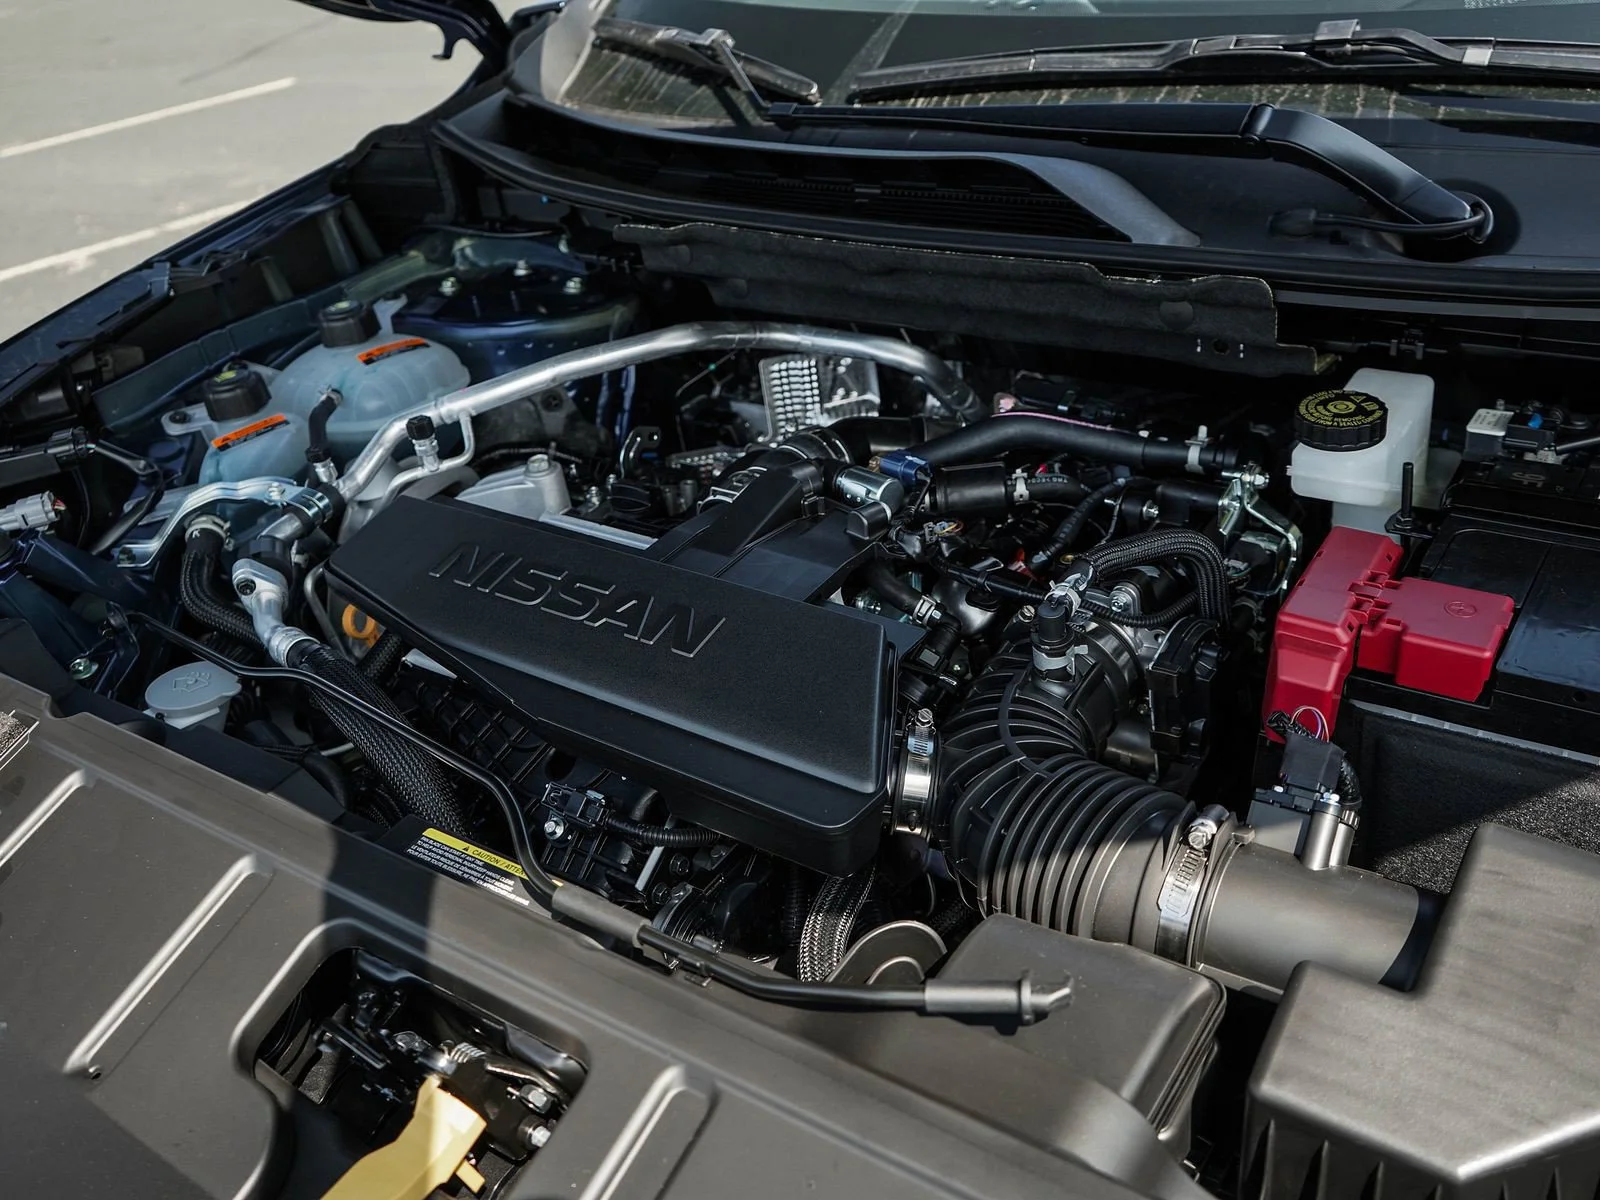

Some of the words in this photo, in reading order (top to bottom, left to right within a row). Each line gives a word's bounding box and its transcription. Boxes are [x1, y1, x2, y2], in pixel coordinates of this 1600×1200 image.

[429, 543, 726, 658] NISSAN
[472, 849, 501, 864] CAUTION
[504, 863, 526, 875] ATTEN
